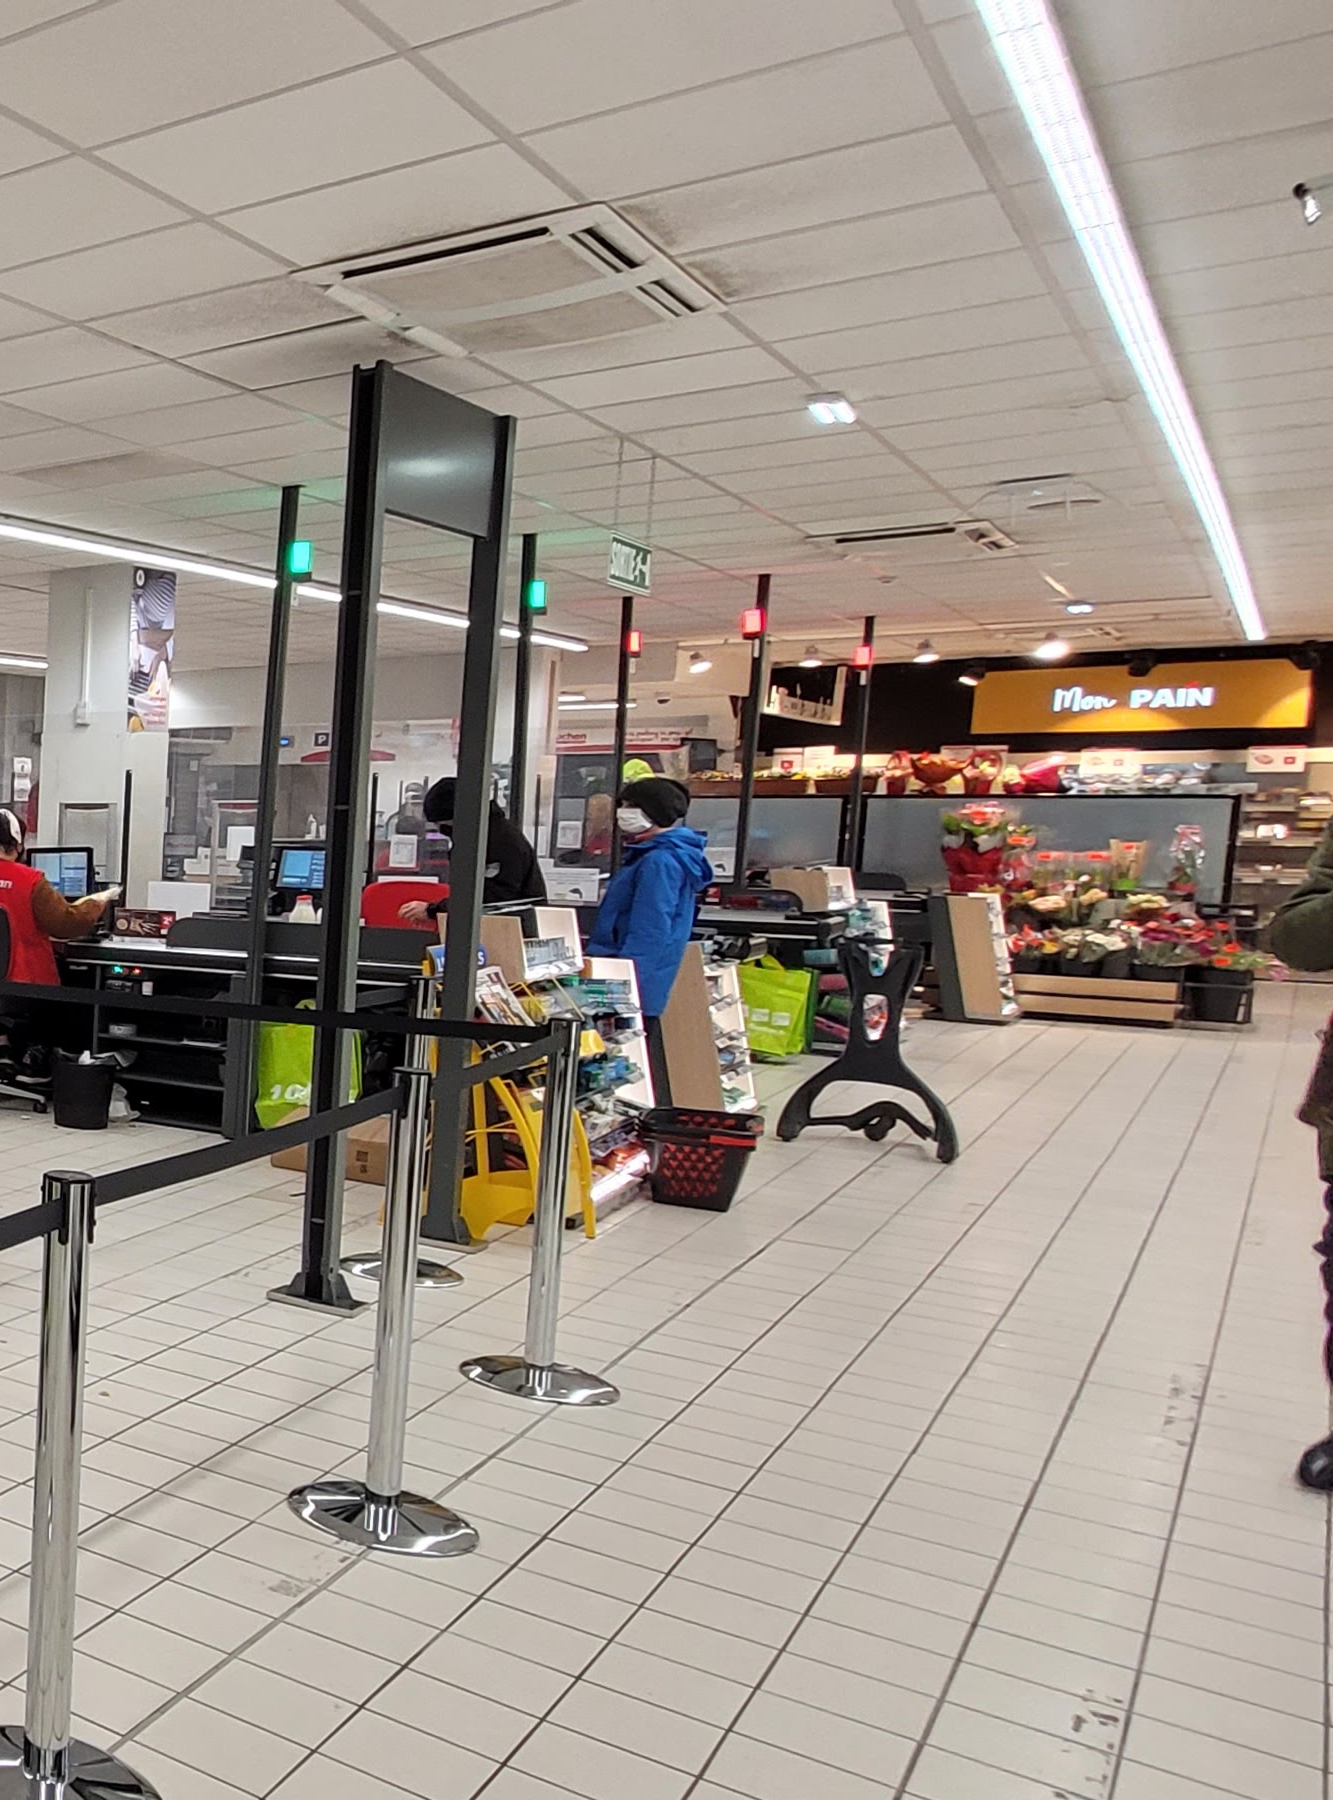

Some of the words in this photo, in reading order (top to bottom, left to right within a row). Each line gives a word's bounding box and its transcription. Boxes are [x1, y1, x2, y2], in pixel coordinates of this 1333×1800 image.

[1053, 686, 1117, 712] Mon
[1129, 687, 1215, 709] PAIN
[318, 735, 327, 744] P
